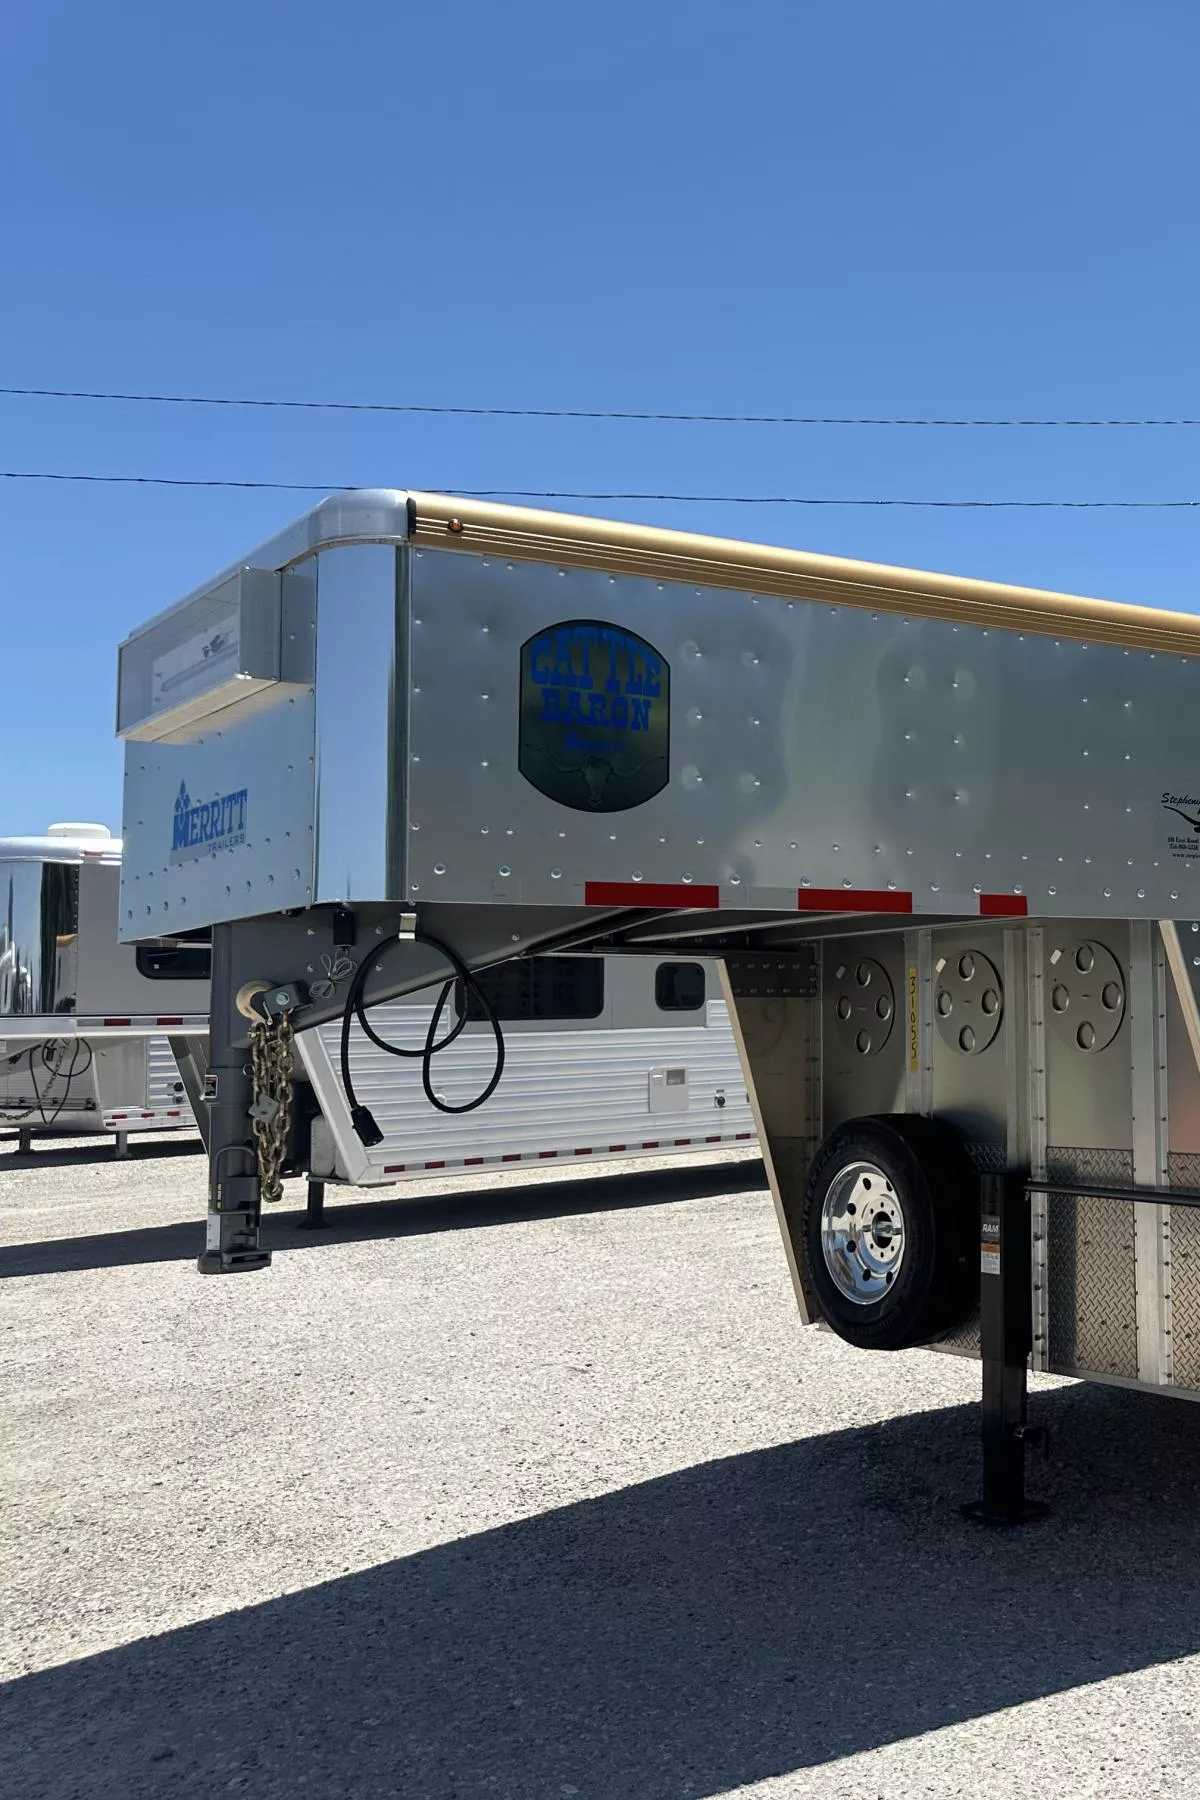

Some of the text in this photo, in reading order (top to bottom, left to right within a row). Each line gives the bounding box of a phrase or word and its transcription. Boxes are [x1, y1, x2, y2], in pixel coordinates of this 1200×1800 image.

[530, 626, 661, 698] CATTLE
[541, 688, 652, 732] BARON
[173, 788, 248, 851] MERRITT
[208, 833, 245, 853] TRAILERS
[982, 1223, 999, 1233] RAM
